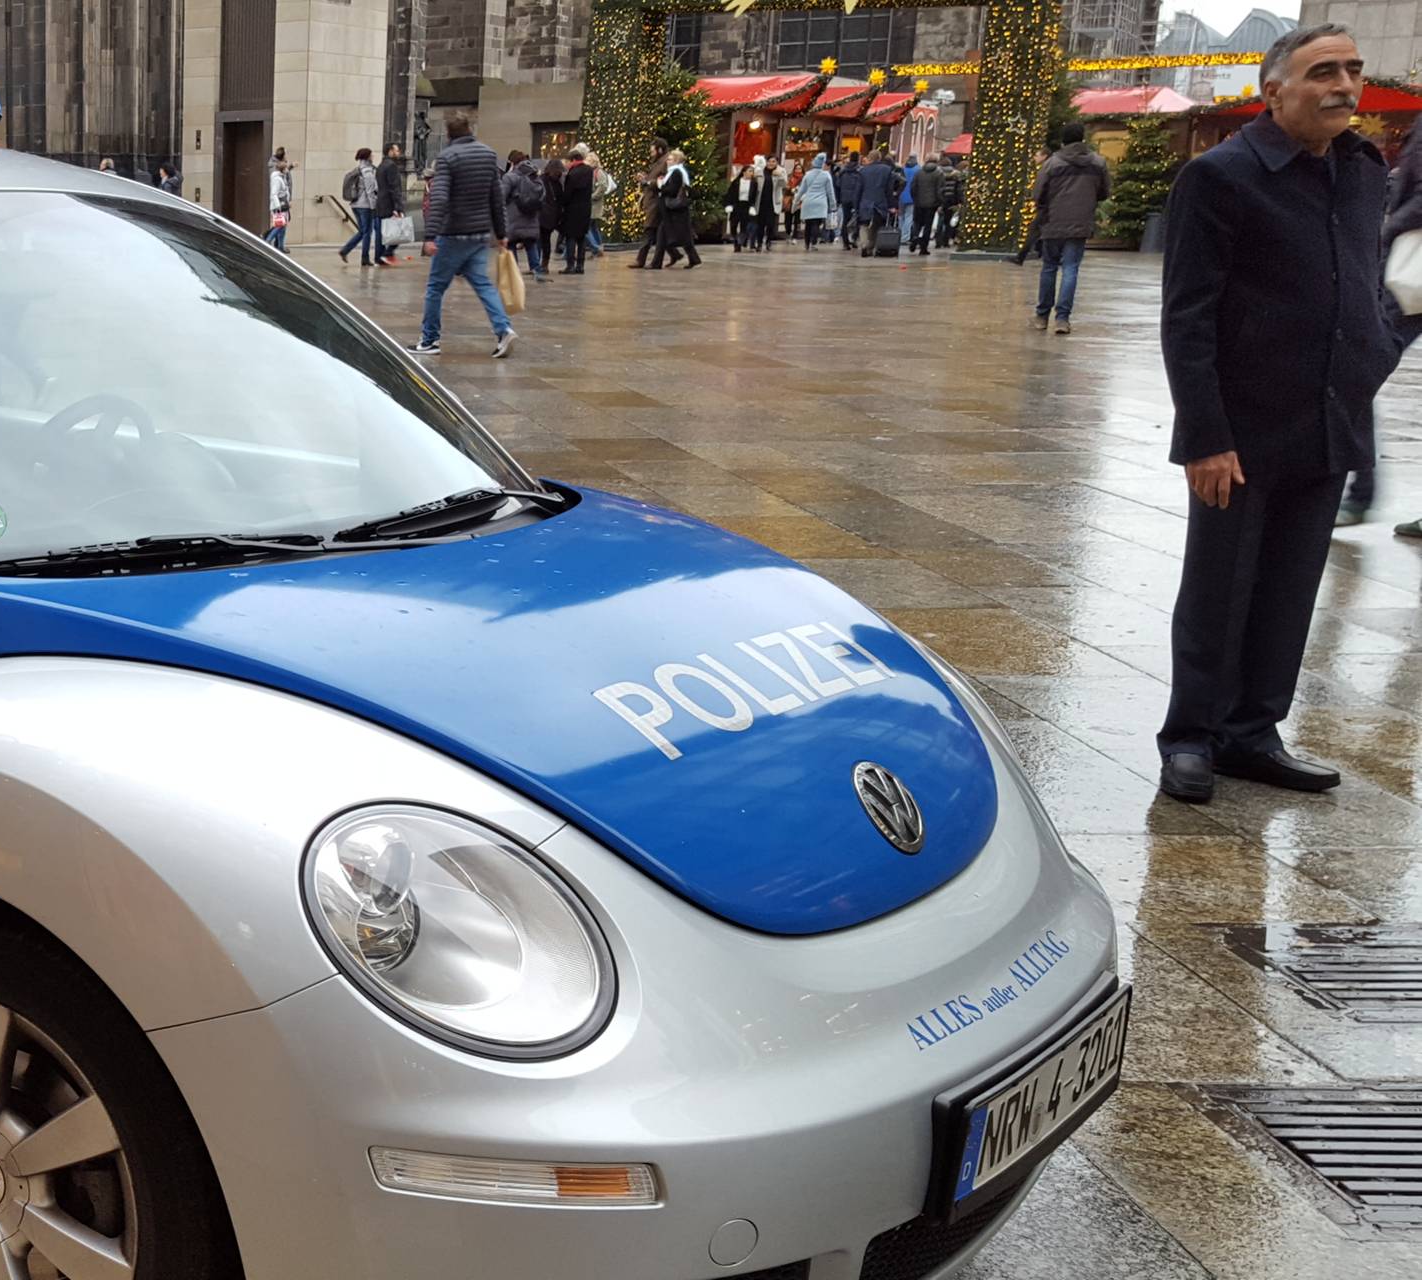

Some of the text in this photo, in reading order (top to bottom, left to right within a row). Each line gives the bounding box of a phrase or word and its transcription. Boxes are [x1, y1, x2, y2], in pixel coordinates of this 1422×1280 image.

[591, 620, 897, 761] POLIZEI
[906, 930, 1070, 1050] ALLES außer ALLTAG
[962, 1161, 972, 1181] D
[977, 1077, 1039, 1177] NRW
